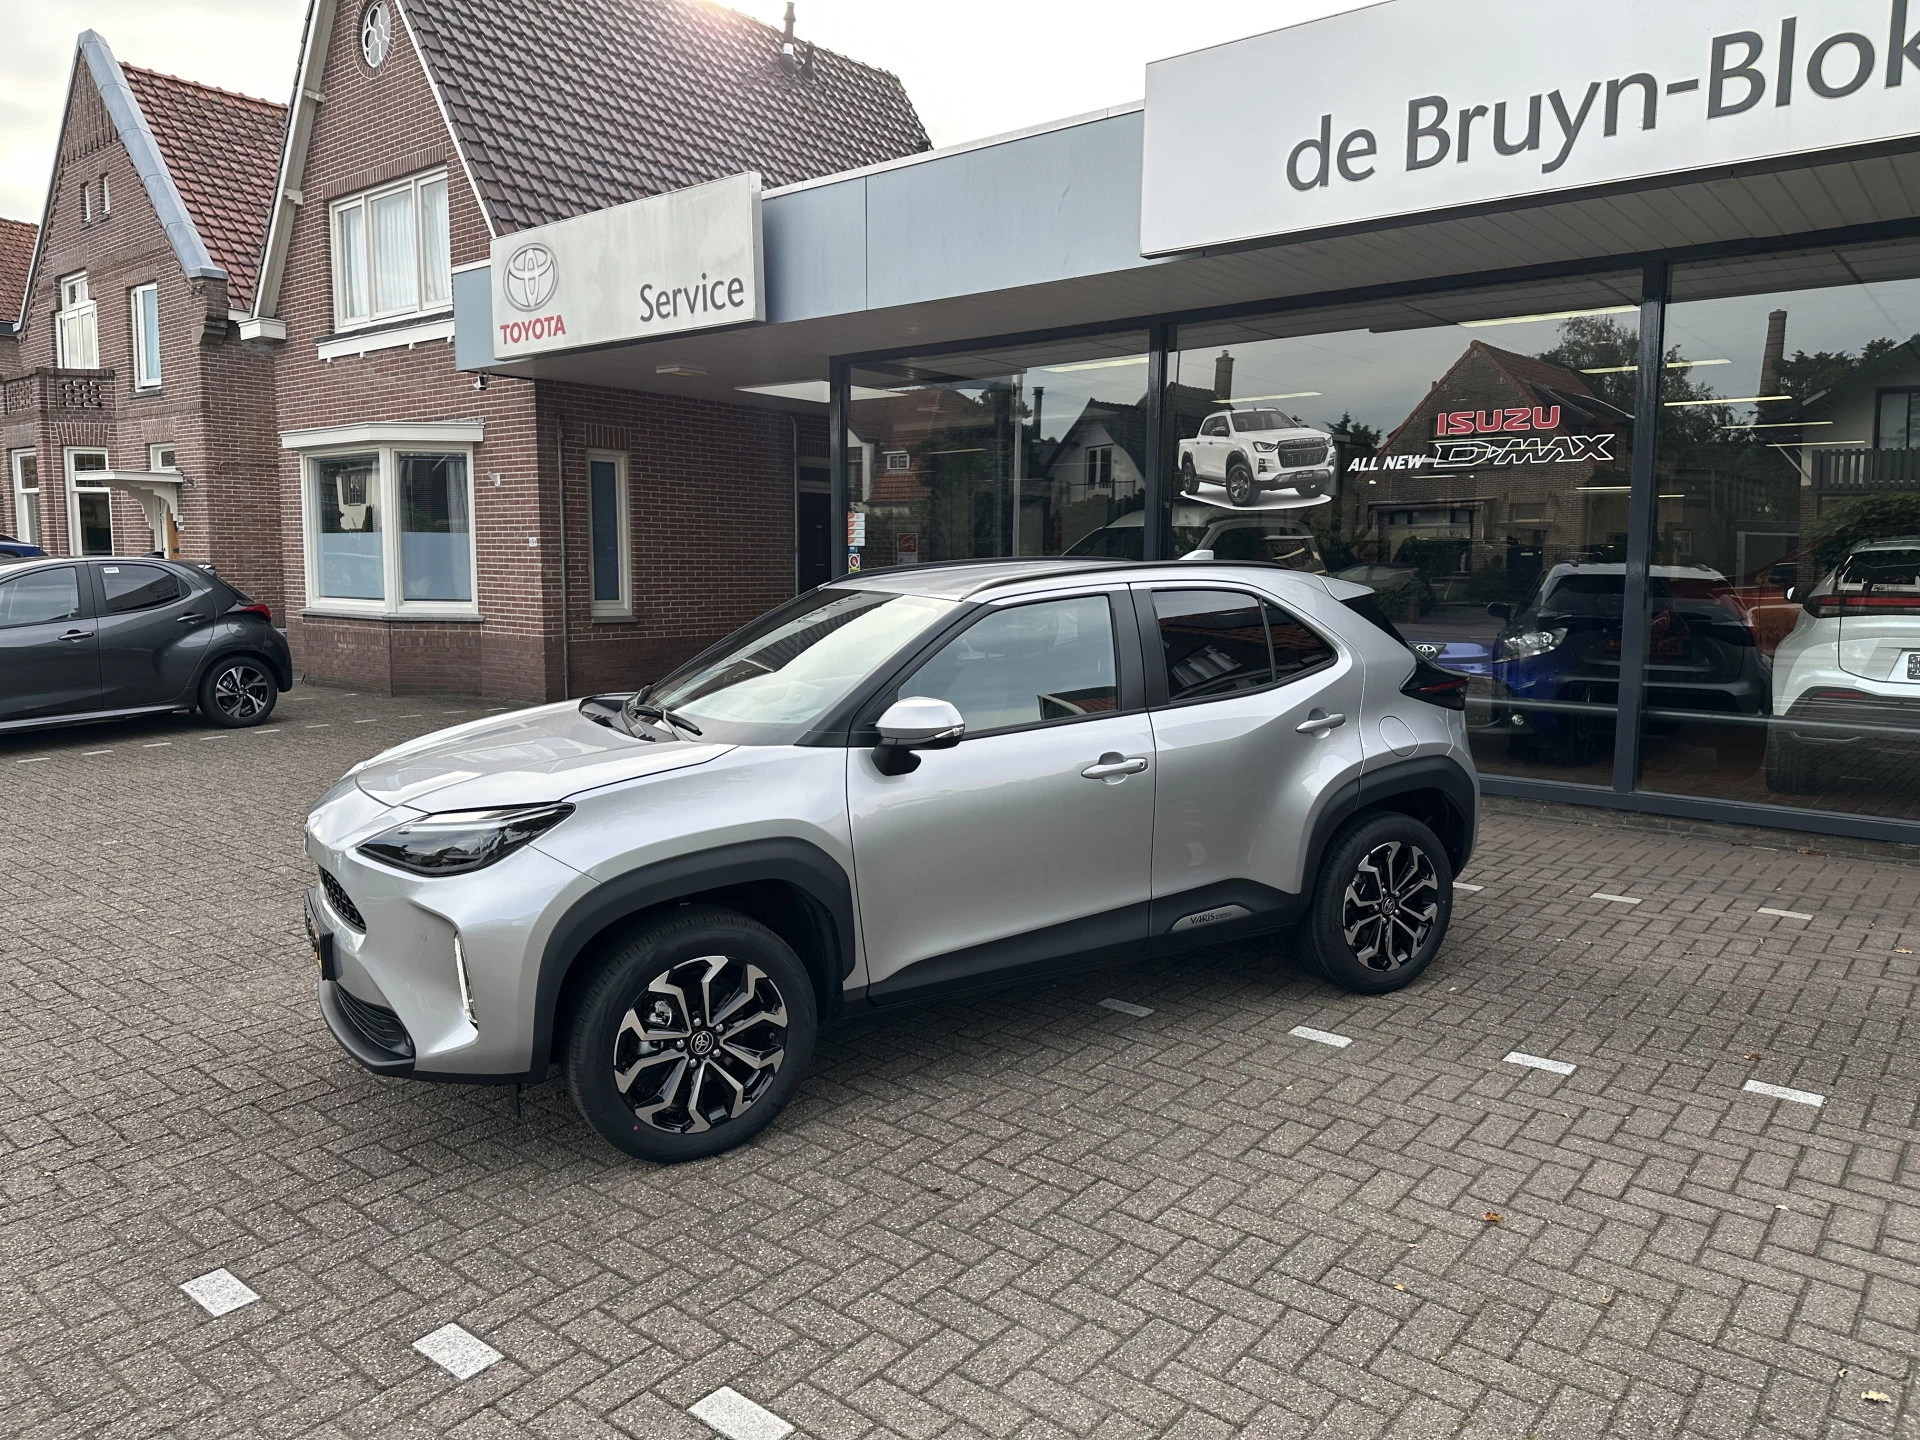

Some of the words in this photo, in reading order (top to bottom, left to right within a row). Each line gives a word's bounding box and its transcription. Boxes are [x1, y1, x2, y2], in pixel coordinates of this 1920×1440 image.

[1286, 114, 1377, 192] de
[639, 272, 745, 322] Service
[500, 314, 567, 345] TOYOTA
[1436, 406, 1561, 436] ISUZU
[1347, 457, 1380, 472] ALL
[1382, 454, 1427, 470] NEW
